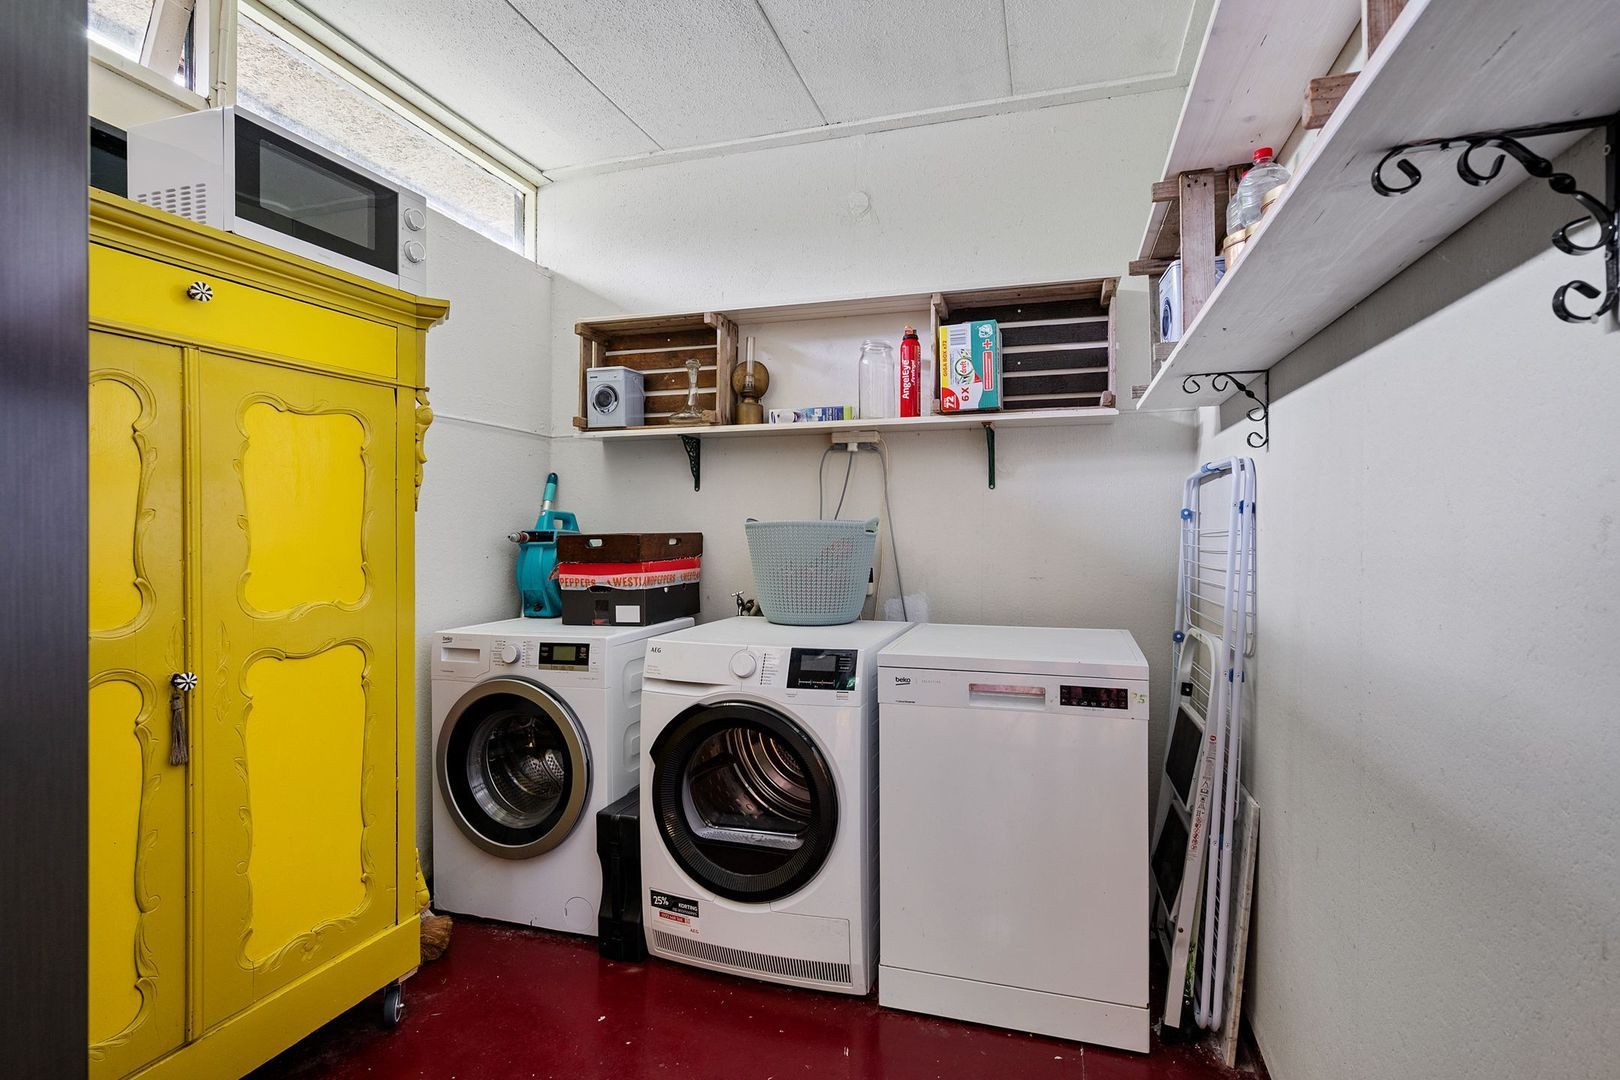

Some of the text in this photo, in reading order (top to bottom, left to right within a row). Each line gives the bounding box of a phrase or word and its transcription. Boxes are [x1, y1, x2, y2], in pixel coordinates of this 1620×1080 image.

[902, 359, 911, 399] AngelEye
[946, 396, 955, 408] 72
[653, 896, 669, 905] 25%
[678, 903, 698, 911] KORTING
